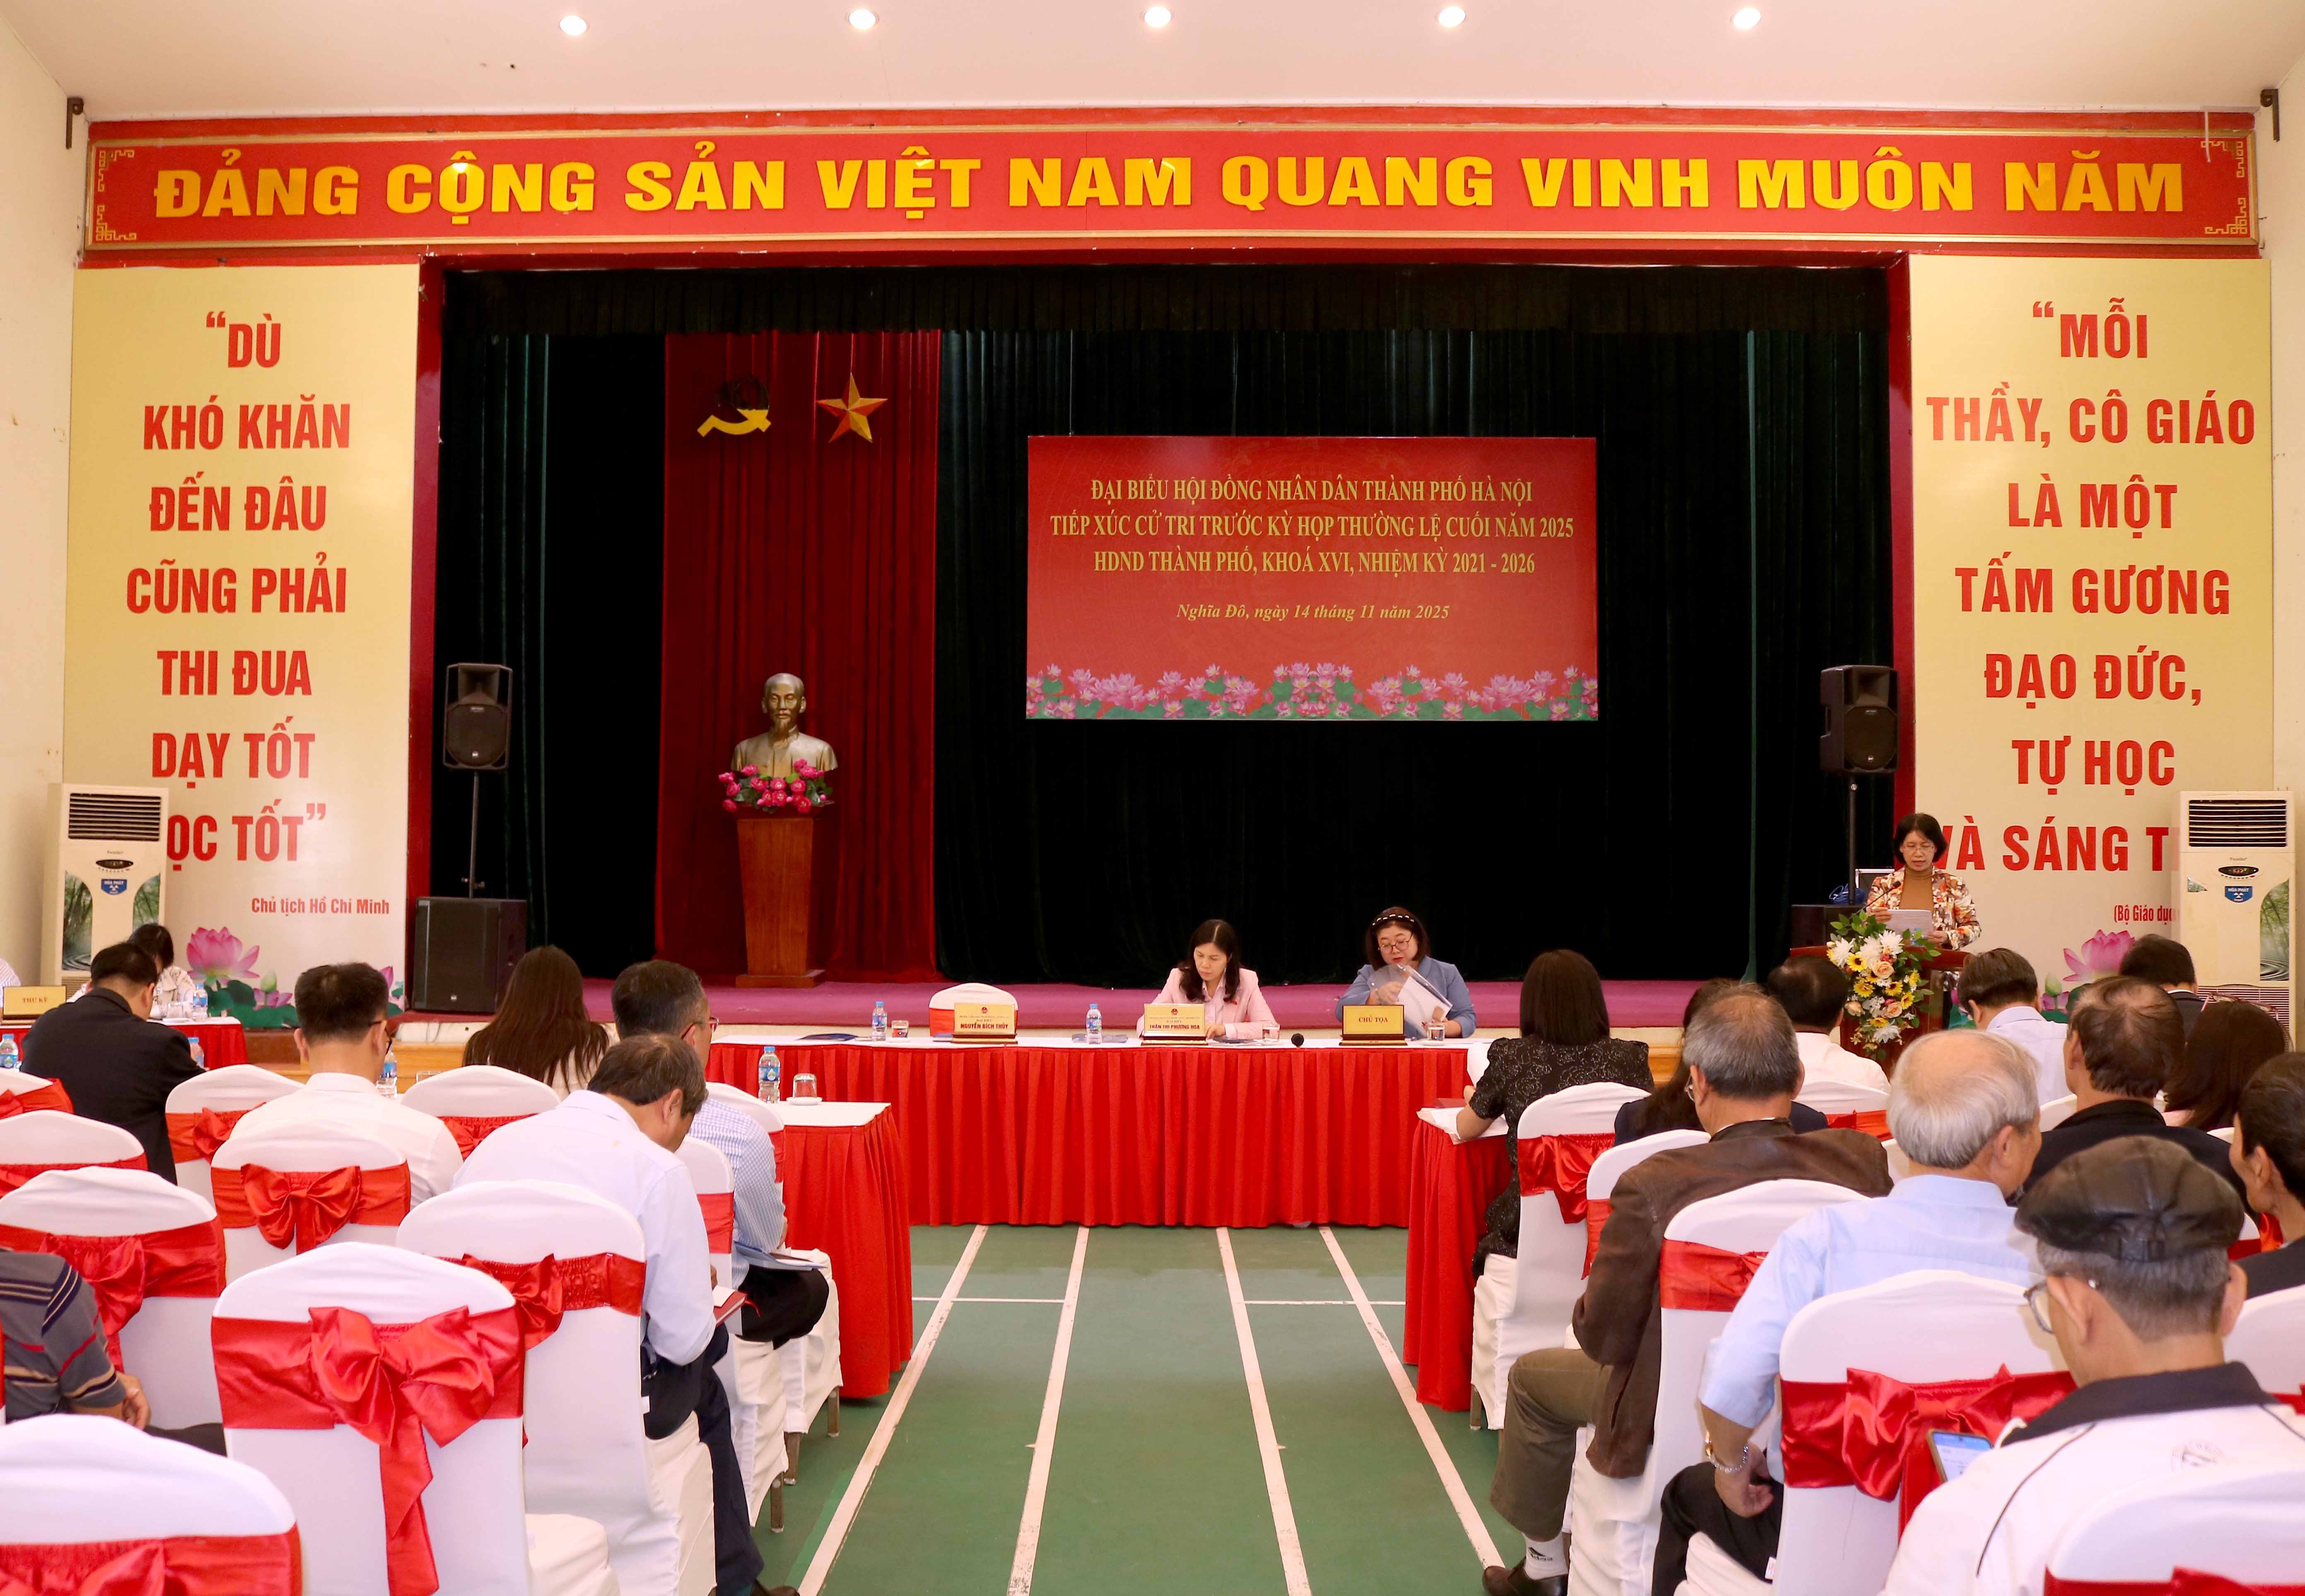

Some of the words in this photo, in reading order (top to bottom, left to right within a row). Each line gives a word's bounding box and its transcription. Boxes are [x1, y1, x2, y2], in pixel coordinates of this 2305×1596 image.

[153, 148, 359, 218] ĐẢNG
[387, 150, 594, 224] CỘNG
[625, 141, 784, 212] SẢN
[817, 146, 981, 219] VIỆT
[1009, 157, 1192, 207] NAM
[1222, 156, 1493, 212] QUANG
[1521, 158, 1709, 207] VINH
[1738, 146, 1973, 211] MUÔN
[2004, 150, 2183, 212] NĂM
[206, 311, 281, 368] “DÙ
[2033, 297, 2148, 358] “MỖI
[143, 394, 224, 450] KHÓ
[238, 394, 350, 449] KHĂN
[1926, 382, 2050, 448] THẦY,
[2069, 389, 2128, 444] CÔ
[2146, 389, 2255, 445] GIÁO
[149, 471, 231, 531] ĐẾN
[244, 475, 327, 531] ĐÂU
[1091, 479, 1122, 505] ĐẠI
[1127, 473, 1168, 500] BIỂU
[1173, 476, 1206, 505] HỘI
[1210, 474, 1262, 501] ĐỒNG
[1266, 474, 1317, 501] NHÂN
[1321, 474, 1358, 501] DÂN
[1362, 474, 1424, 501] THÀNH
[1429, 475, 1466, 502] PHỐ
[1470, 475, 1496, 502] HÀ
[1500, 478, 1533, 507] NỘI
[2008, 473, 2062, 528] LÀ
[2080, 474, 2178, 539] MỘT
[1050, 509, 1090, 536] TIẾP
[1093, 509, 1130, 536] XÚC
[1135, 509, 1162, 536] CỬ
[1165, 515, 1195, 536] TRI
[1199, 509, 1262, 536] TRƯỚC
[1267, 510, 1293, 536] KỲ
[1297, 516, 1334, 542] HỌP
[1337, 510, 1415, 537] THƯỜNG
[1419, 513, 1441, 542] LỆ
[1446, 511, 1490, 538] CUỐI
[1495, 511, 1535, 537] NĂM
[1540, 517, 1574, 538] 2025
[126, 558, 237, 614] CŨNG
[251, 551, 347, 613] PHẢI
[1094, 550, 1144, 572] HDND
[1148, 545, 1211, 572] THÀNH
[1216, 546, 1258, 576] PHỐ,
[1262, 546, 1314, 572] KHOÁ
[1319, 551, 1355, 576] XVI,
[1358, 548, 1418, 578] NHIỆM
[1423, 546, 1448, 573] KỲ
[1452, 552, 1485, 573] 2021
[1501, 553, 1535, 574] 2026
[1954, 551, 2053, 613] TẤM
[2072, 564, 2230, 615] GƯƠNG
[1177, 603, 1220, 622] Nghĩa
[1224, 604, 1249, 621] Đô,
[1254, 604, 1289, 622] ngày
[1293, 605, 1310, 618] 14
[1314, 604, 1356, 622] tháng
[1359, 605, 1375, 618] 11
[1380, 605, 1411, 619] năm
[1415, 605, 1450, 619] 2025
[156, 650, 218, 696] THI
[231, 650, 312, 696] ĐUA
[1984, 653, 2076, 709] ĐẠO
[2093, 644, 2202, 706] ĐỨC,
[152, 732, 231, 789] DẠY
[243, 716, 315, 778] TỐT
[2011, 735, 2072, 796] TỰ
[2084, 740, 2175, 796] HỌC
[167, 814, 218, 872] ỌC
[231, 799, 326, 862] TỐT”
[2002, 815, 2129, 872] SÁNG
[251, 896, 276, 913] Chủ
[281, 898, 305, 917] tịch
[310, 896, 326, 913] Hồ
[331, 898, 352, 914] Chí
[356, 899, 390, 914] Minh
[2114, 904, 2130, 925] (Bộ
[2132, 904, 2154, 921] Giáo
